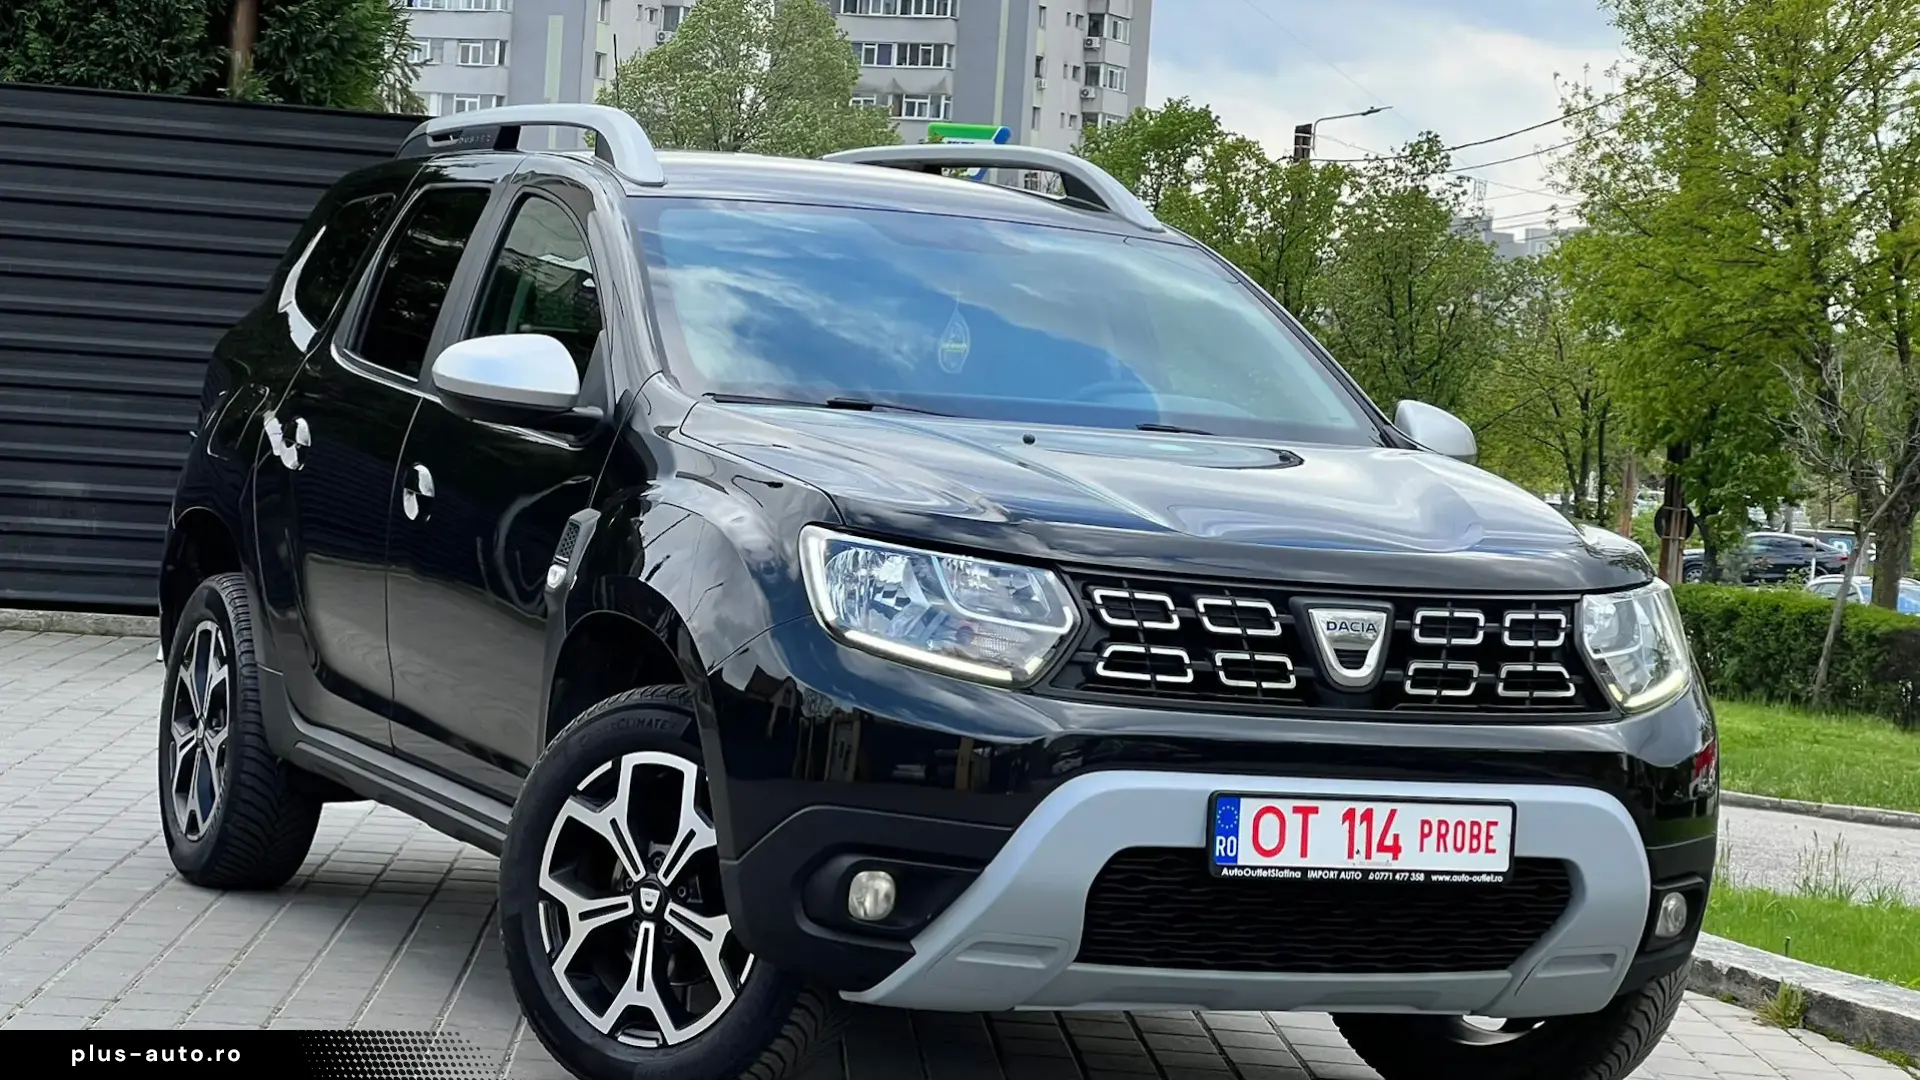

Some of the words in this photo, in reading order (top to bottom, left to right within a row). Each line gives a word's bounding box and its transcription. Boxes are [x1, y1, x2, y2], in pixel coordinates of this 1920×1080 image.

[1326, 620, 1378, 633] DACIA
[1252, 805, 1319, 858] OT
[1341, 806, 1402, 861] 114
[1419, 818, 1499, 854] PROBE
[1215, 836, 1237, 857] RO
[1221, 867, 1301, 879] AutoOutletSlatina
[1307, 870, 1338, 880] IMPORT
[1339, 871, 1362, 880] AUTO
[1394, 872, 1409, 881] 477
[1431, 873, 1503, 883] www.auto-outlet.ro
